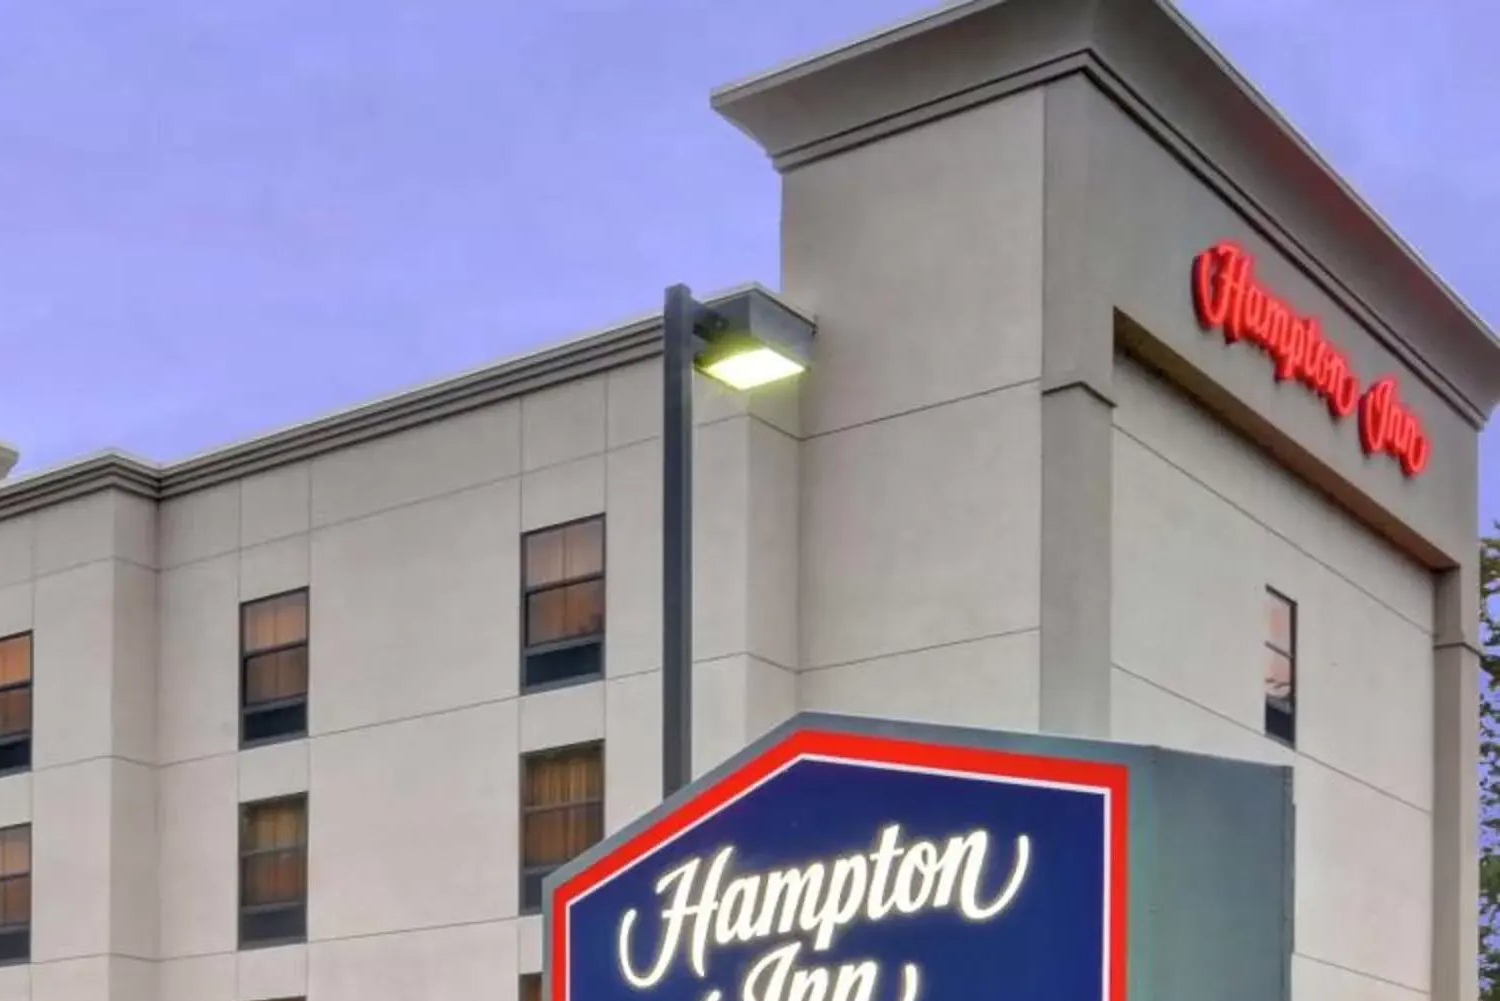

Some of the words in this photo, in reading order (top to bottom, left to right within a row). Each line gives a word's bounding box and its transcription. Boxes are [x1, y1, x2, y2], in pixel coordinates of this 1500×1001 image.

[1192, 242, 1358, 418] Hampton
[1359, 378, 1430, 476] Inn
[619, 825, 1029, 988] Hampton
